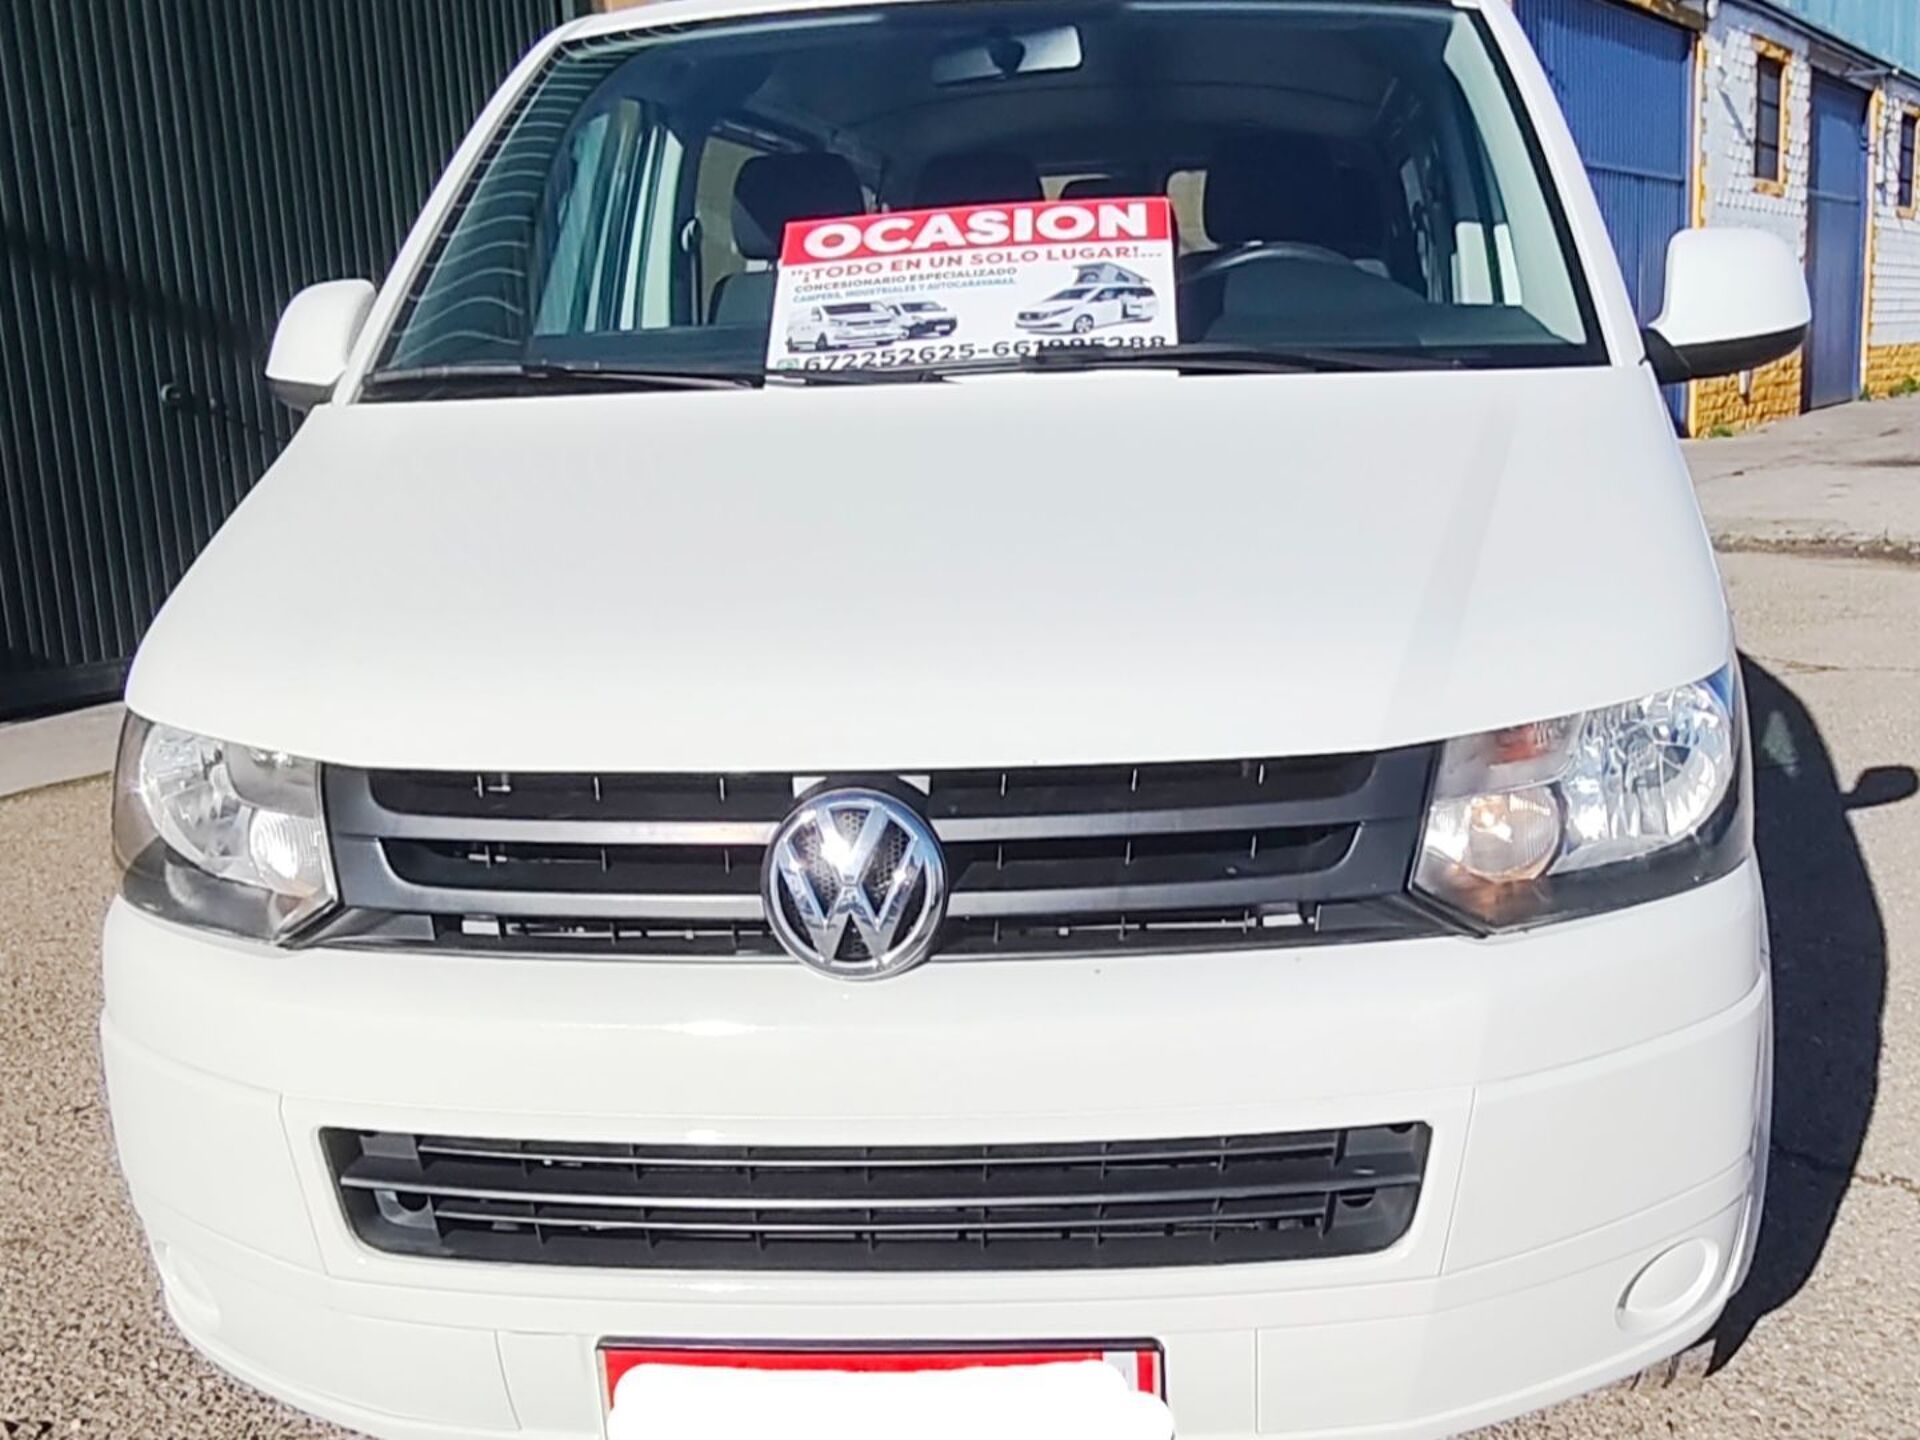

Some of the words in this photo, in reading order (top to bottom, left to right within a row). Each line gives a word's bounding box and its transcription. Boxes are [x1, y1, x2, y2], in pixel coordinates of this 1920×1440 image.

[803, 203, 1147, 258] OCASION
[891, 258, 921, 272] EN
[929, 254, 963, 268] UN
[970, 250, 1039, 265] SOLO
[794, 275, 906, 294] CONCESIONARIO
[909, 266, 1018, 283] ESPECIALIZADO
